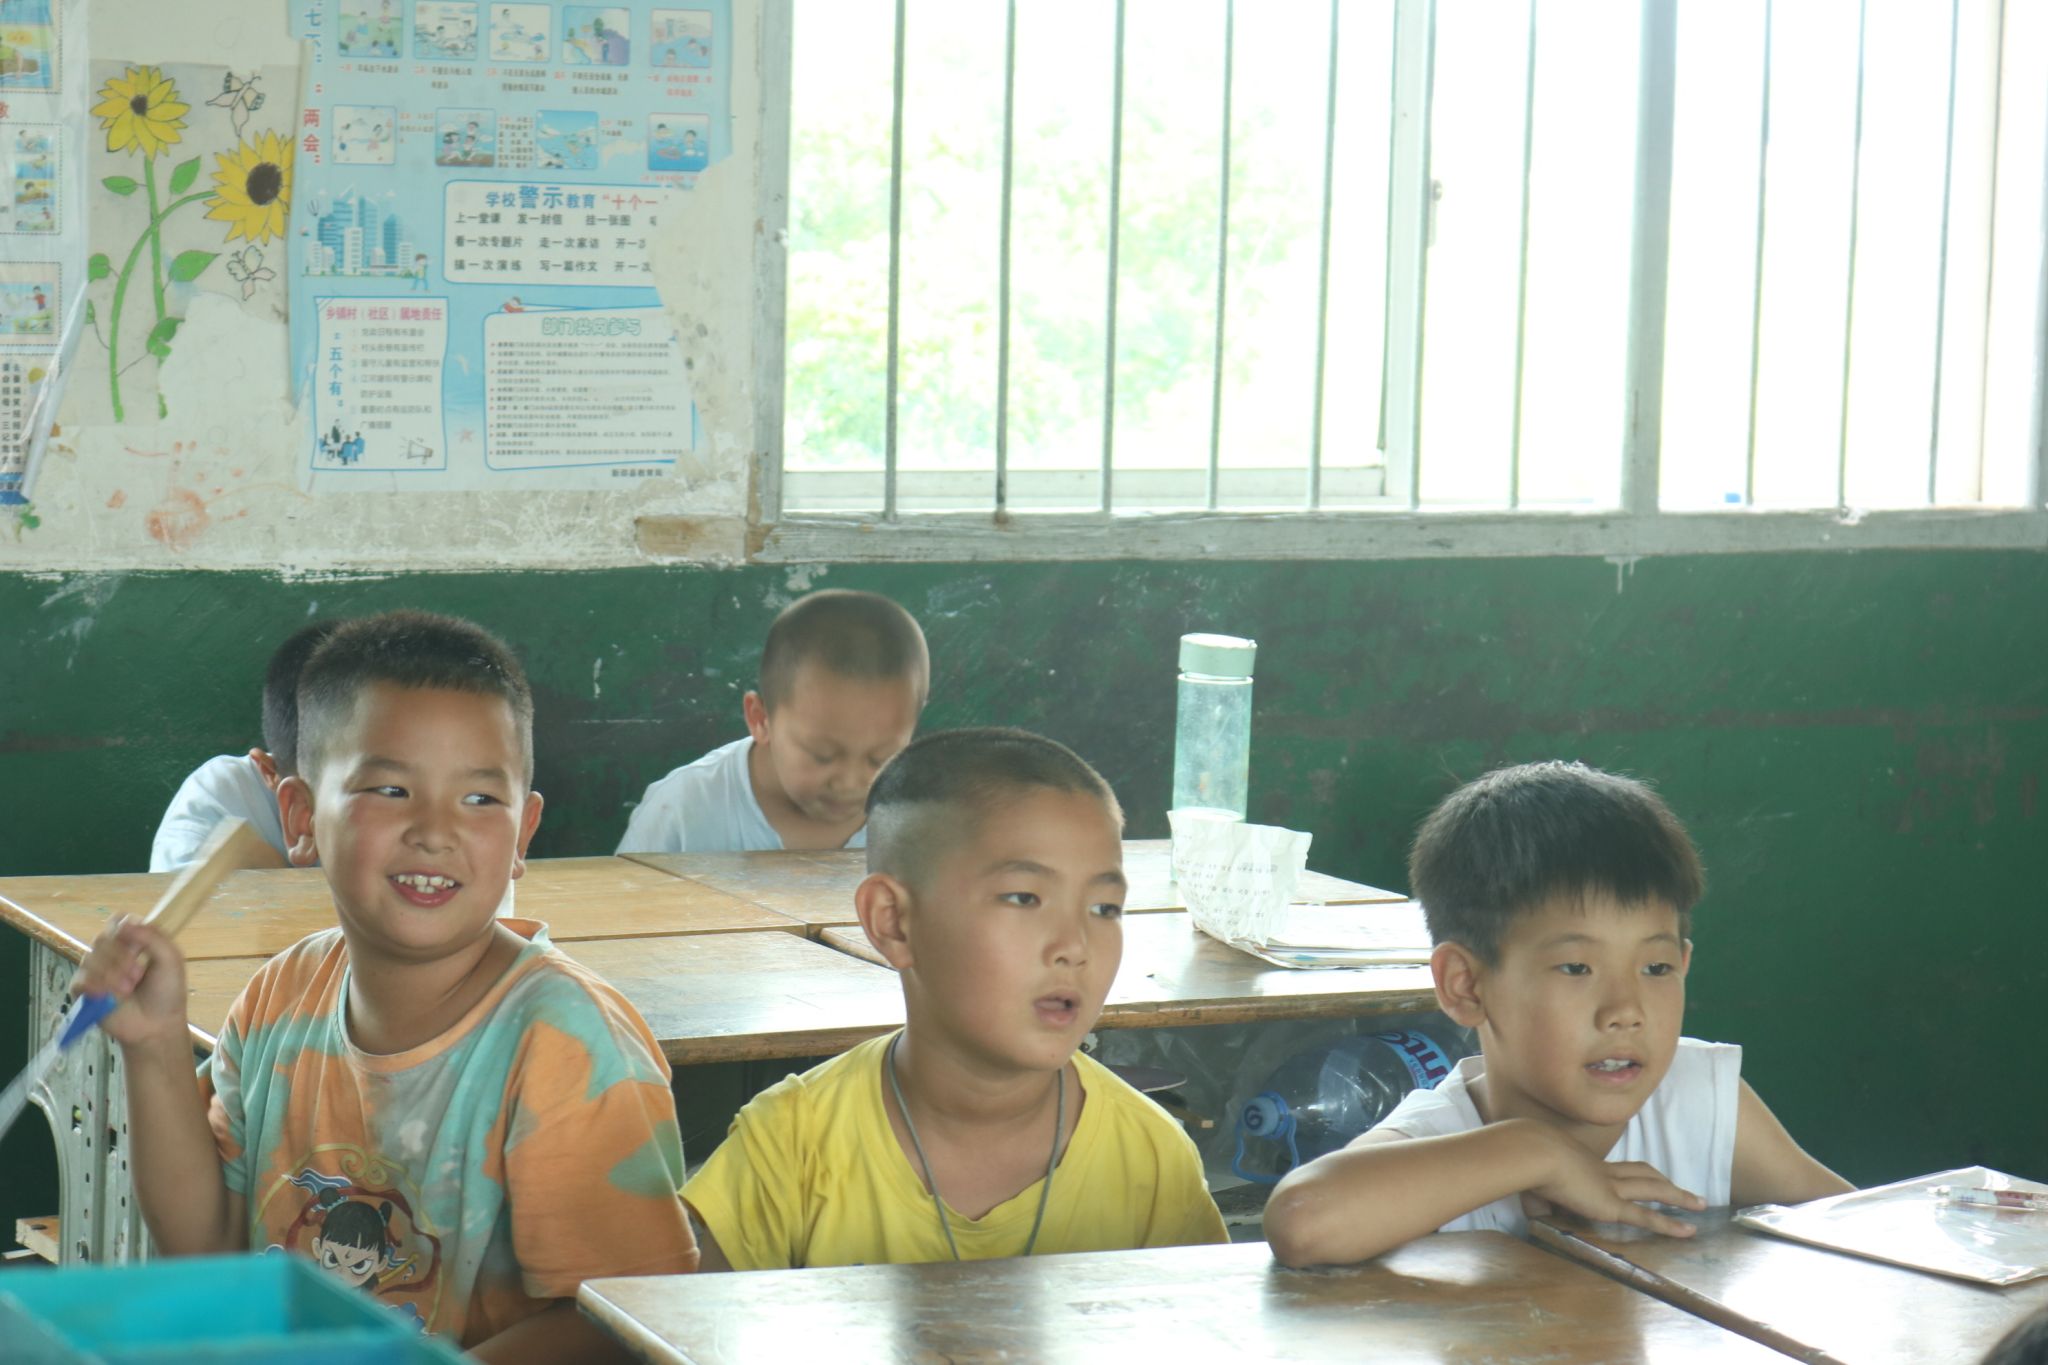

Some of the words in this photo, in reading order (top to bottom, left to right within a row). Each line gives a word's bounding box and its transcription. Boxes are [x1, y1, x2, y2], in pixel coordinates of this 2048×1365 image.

[454, 212, 502, 225] 上一堂课
[517, 212, 563, 226] 发一封信
[454, 234, 524, 249] 看一次专题片
[539, 260, 598, 273] 写一篇作文
